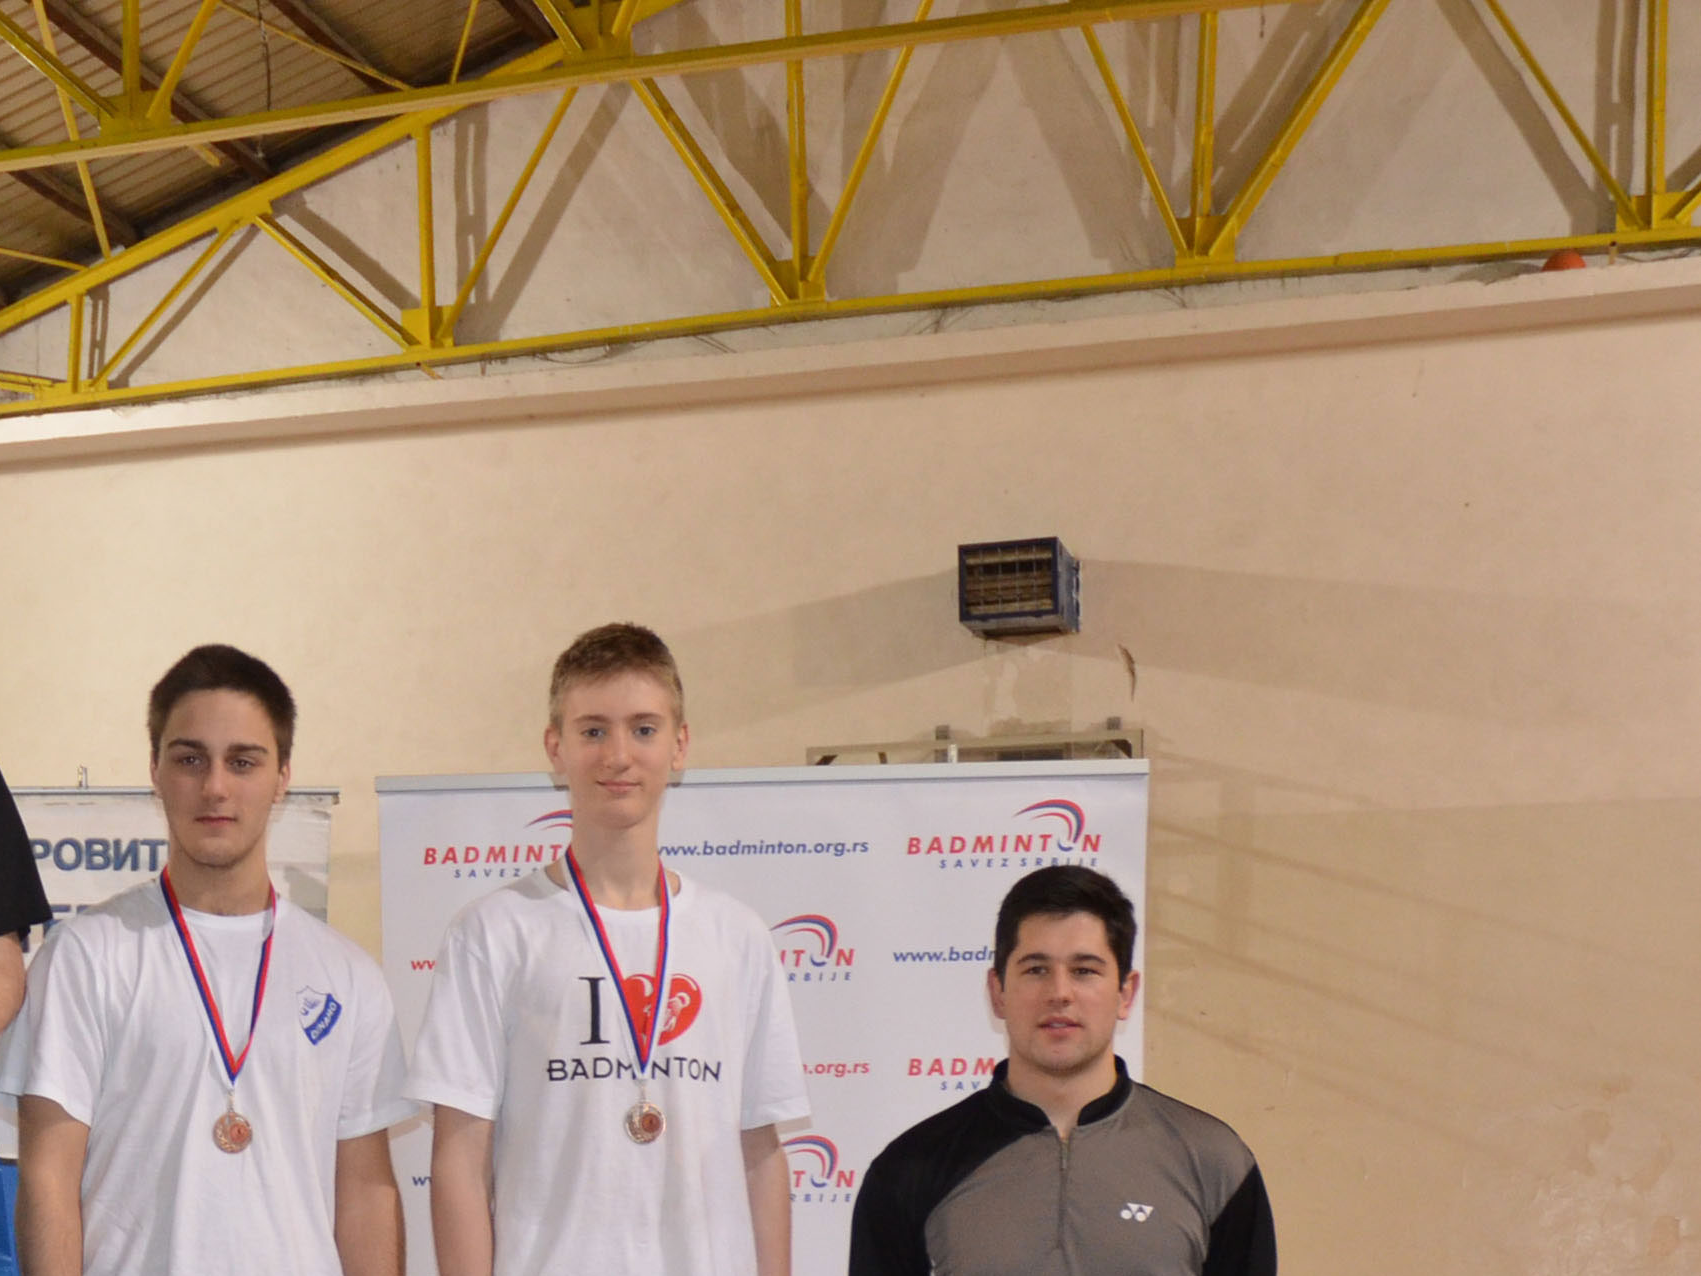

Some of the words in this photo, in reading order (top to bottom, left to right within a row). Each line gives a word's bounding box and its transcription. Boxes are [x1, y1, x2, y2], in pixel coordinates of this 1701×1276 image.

[30, 837, 167, 872] РОВИТ
[423, 844, 564, 865] BADMINT
[907, 833, 1101, 855] BADMINTON
[454, 867, 522, 879] SAVEZ
[939, 857, 1009, 869] SAVEZ
[579, 976, 611, 1046] I
[547, 1055, 722, 1082] BADMNTON
